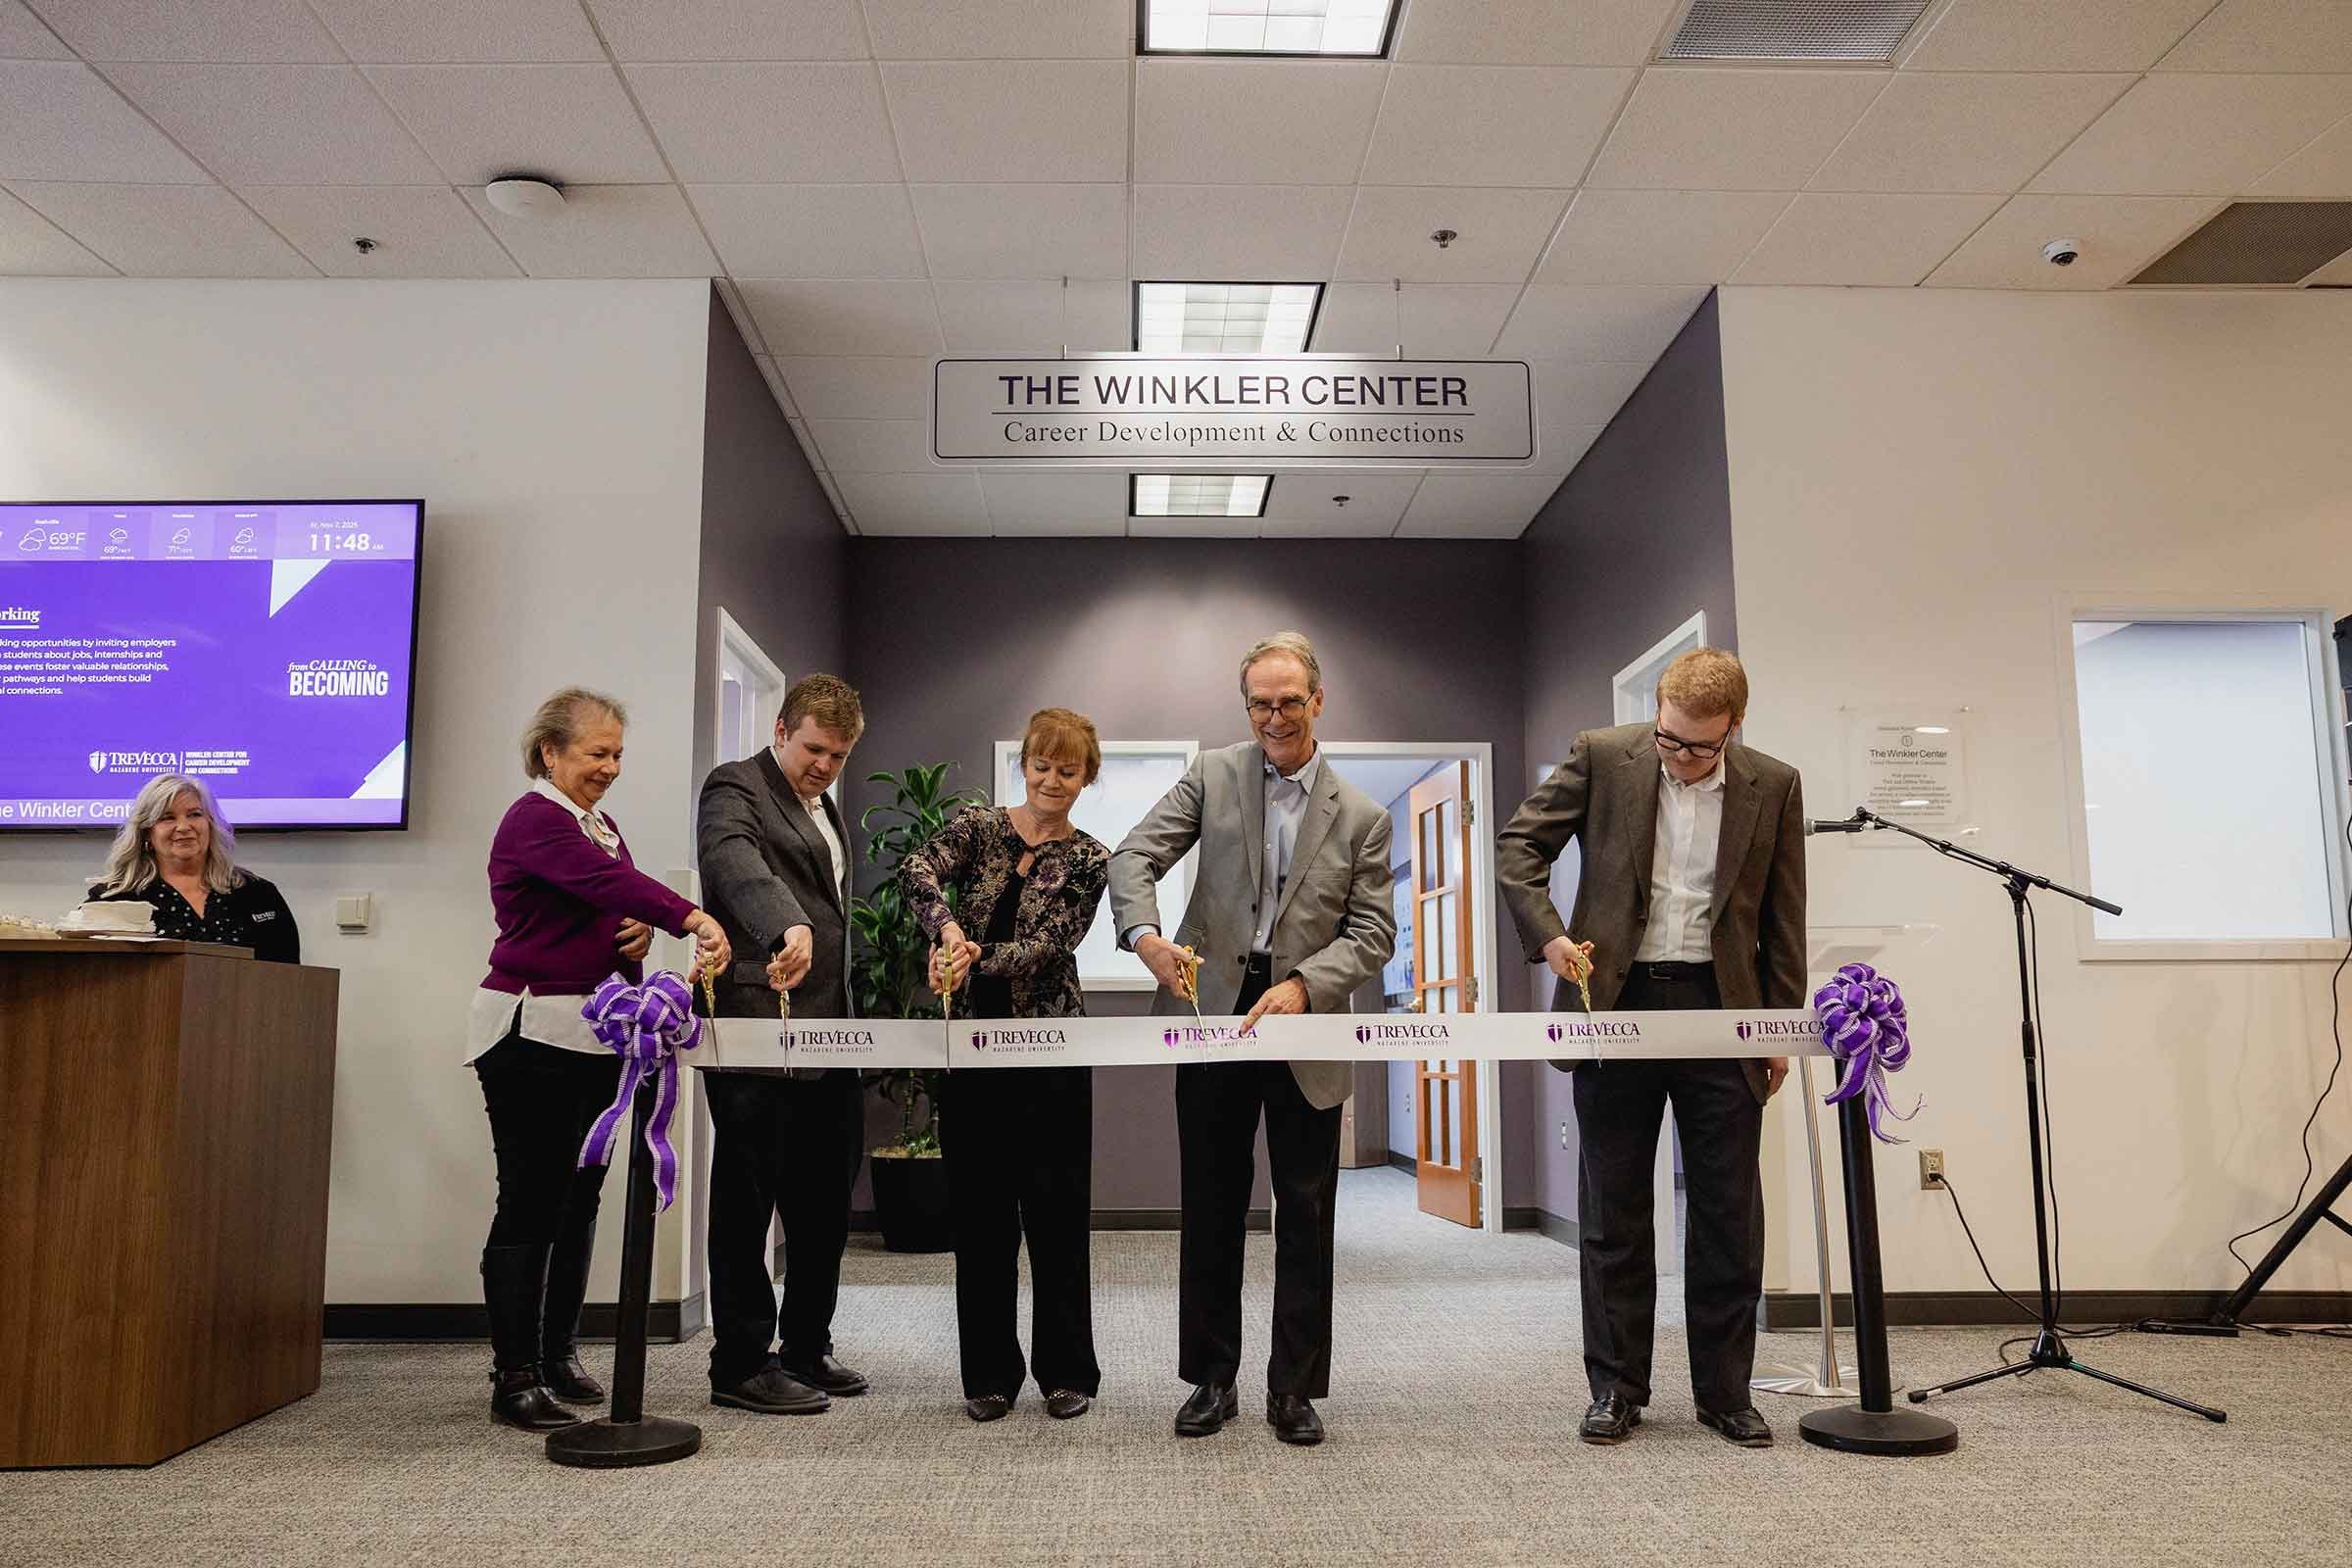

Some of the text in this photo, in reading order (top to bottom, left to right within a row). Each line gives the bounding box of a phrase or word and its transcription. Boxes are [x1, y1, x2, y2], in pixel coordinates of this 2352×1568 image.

[998, 375, 1468, 407] THE WINKLER CENTER
[1004, 420, 1466, 448] Career Development & Connections
[49, 532, 87, 546] 69°F
[310, 532, 370, 551] 11:48
[0, 607, 41, 623] rking
[21, 639, 81, 649] opportunities
[82, 639, 95, 649] by
[95, 639, 129, 649] inviting
[129, 639, 177, 649] employers
[3, 651, 43, 660] students
[43, 651, 71, 660] about
[94, 651, 144, 661] internships
[144, 651, 163, 660] and
[45, 662, 72, 671] foster
[72, 662, 110, 671] valuable
[286, 660, 377, 674] from CALLING to
[2, 674, 152, 685] pathways and help students build
[289, 670, 390, 697] BECOMING
[6, 686, 64, 695] connections.
[109, 751, 178, 765] TREVECCA
[1869, 749, 1948, 759] The Winkler Center
[19, 802, 85, 818] Winkler
[89, 802, 132, 818] Cent
[1373, 1024, 1450, 1039] TREVECCA
[1566, 1021, 1642, 1037] TREVECCA
[1754, 1020, 1826, 1035] TREVECCA
[799, 1029, 875, 1045] TREVECCA
[990, 1028, 1067, 1045] TREVECCA
